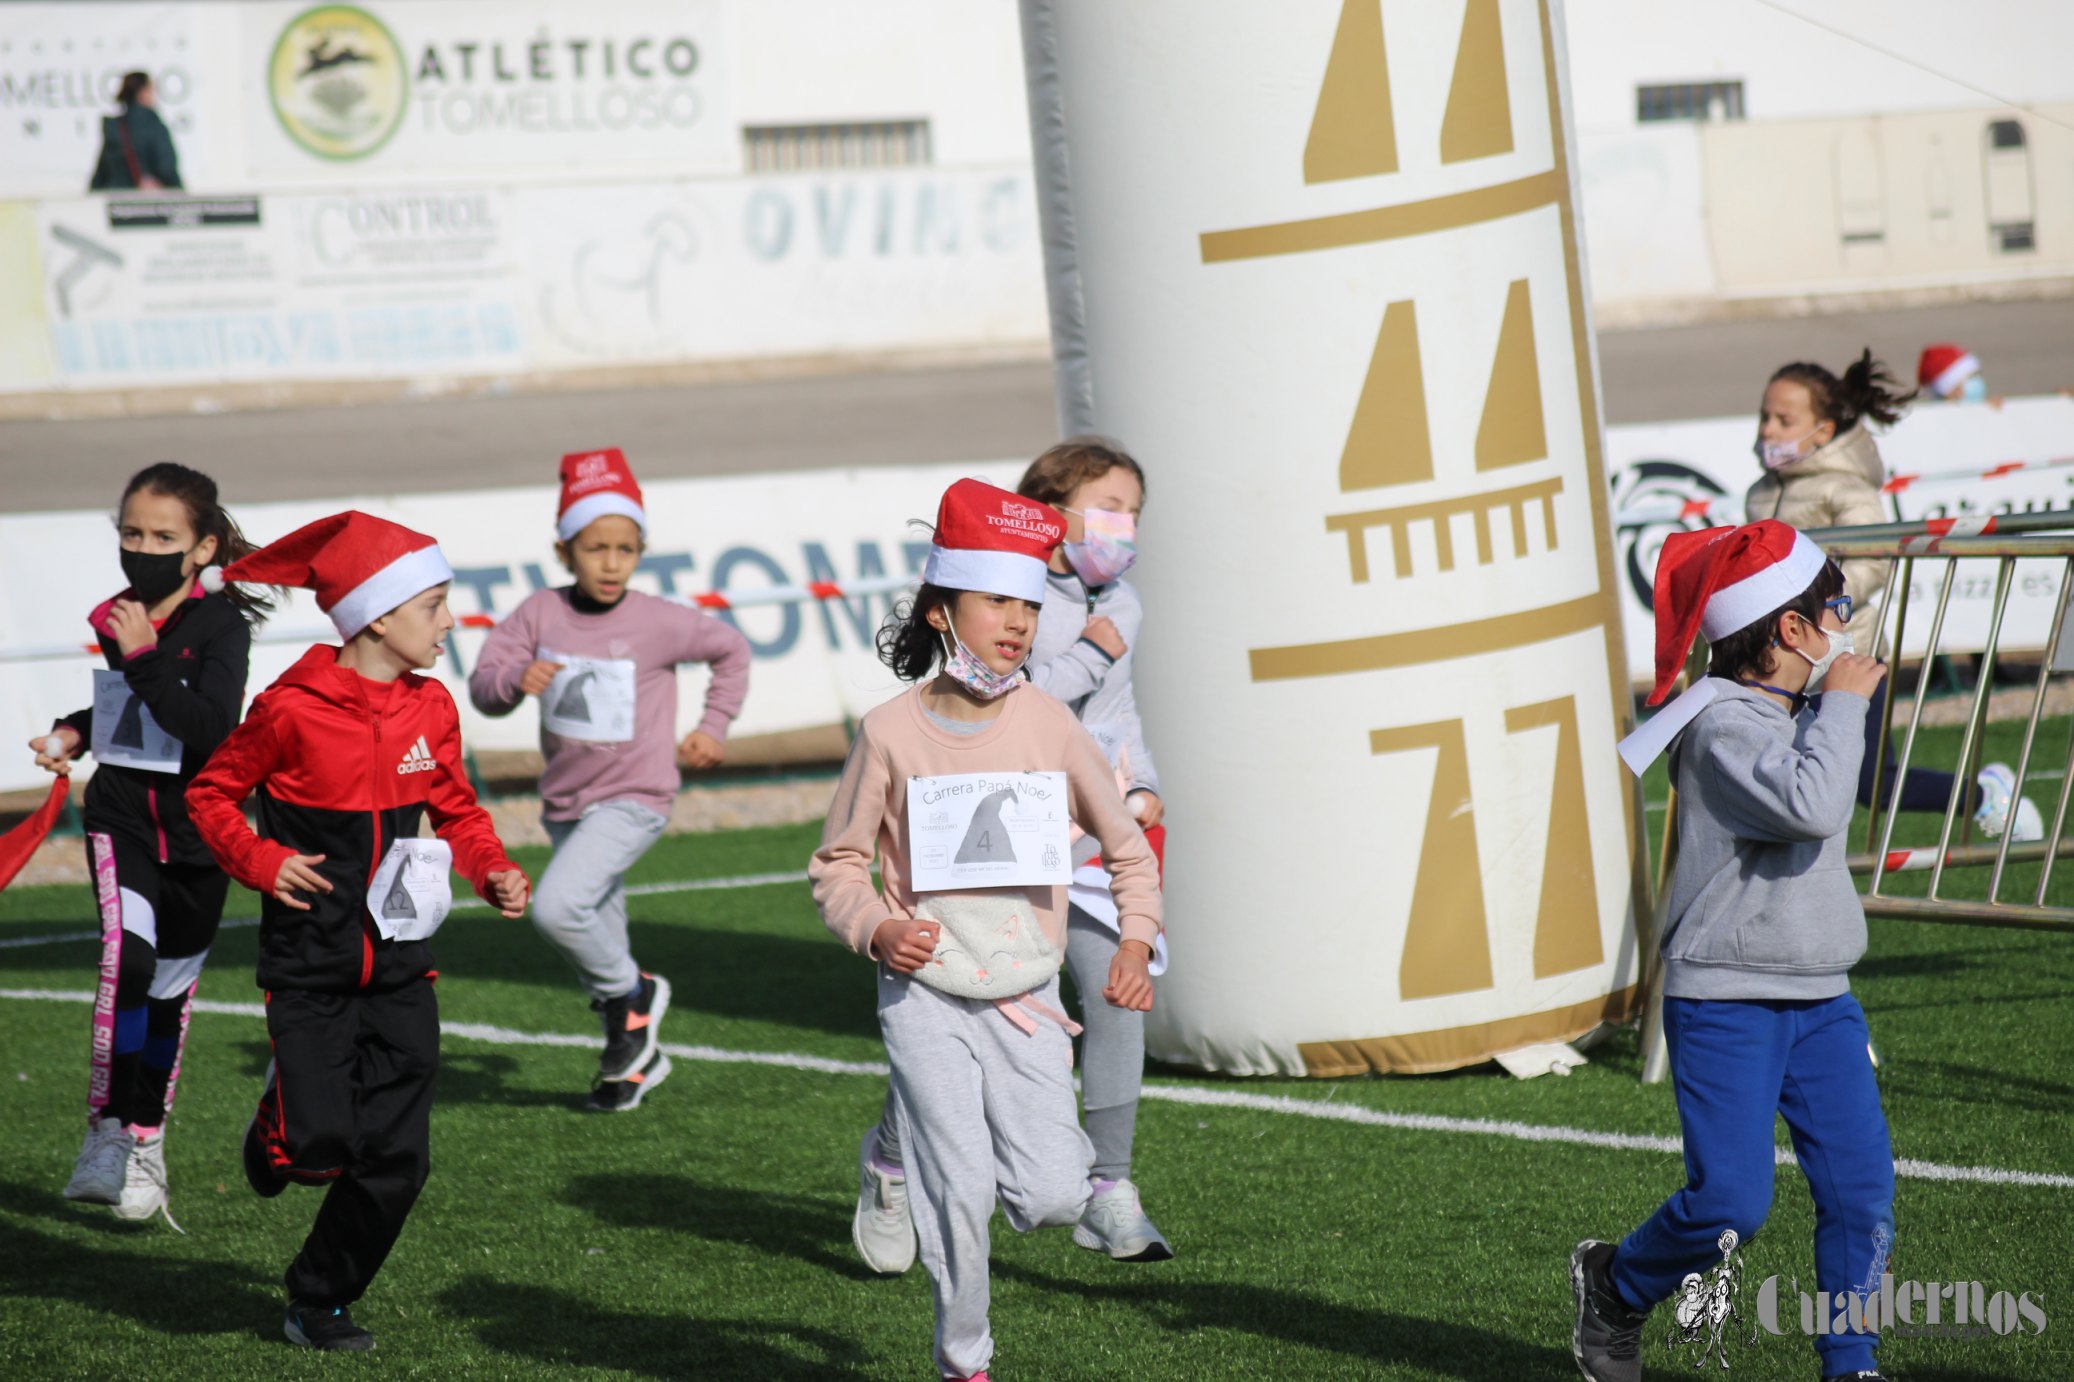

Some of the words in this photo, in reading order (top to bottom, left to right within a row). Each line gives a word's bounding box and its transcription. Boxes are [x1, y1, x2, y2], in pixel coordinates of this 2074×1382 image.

[417, 27, 702, 83] ATLÉTICO
[418, 85, 704, 136] TOMELLOSO
[986, 514, 1060, 539] TOMELLOSO
[1000, 527, 1049, 543] AYUNTAMIENTO
[397, 759, 437, 775] adidas
[922, 783, 974, 805] Carrera
[978, 779, 1013, 796] Papá
[1017, 781, 1053, 801] Noel
[976, 830, 993, 853] 4
